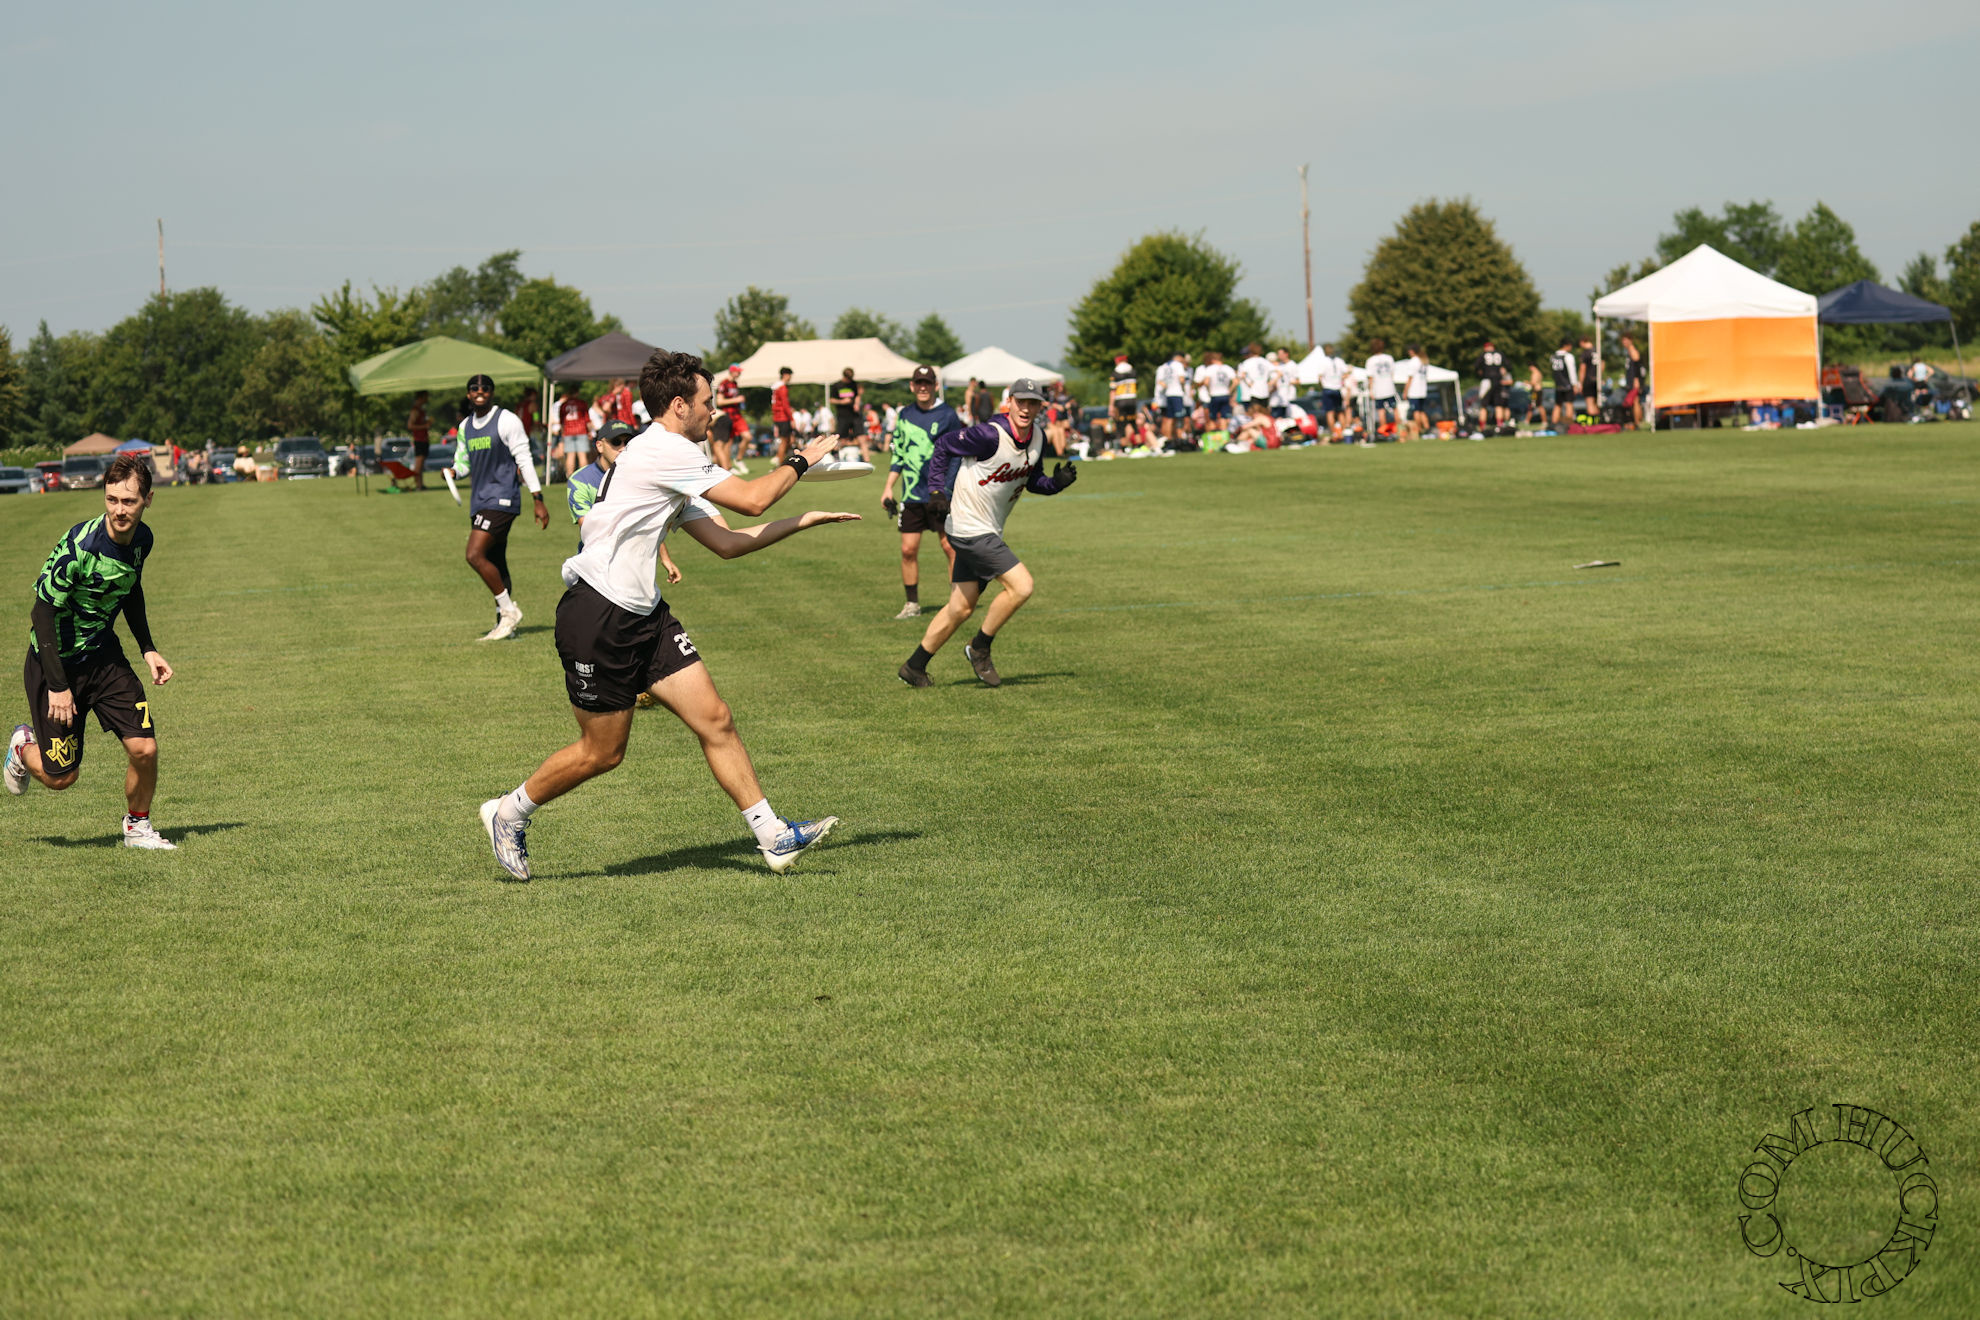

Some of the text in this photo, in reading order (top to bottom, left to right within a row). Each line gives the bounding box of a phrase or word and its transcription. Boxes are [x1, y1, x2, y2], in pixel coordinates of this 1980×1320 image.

[930, 422, 939, 436] 8
[575, 661, 595, 674] FIRST
[135, 701, 152, 729] 7
